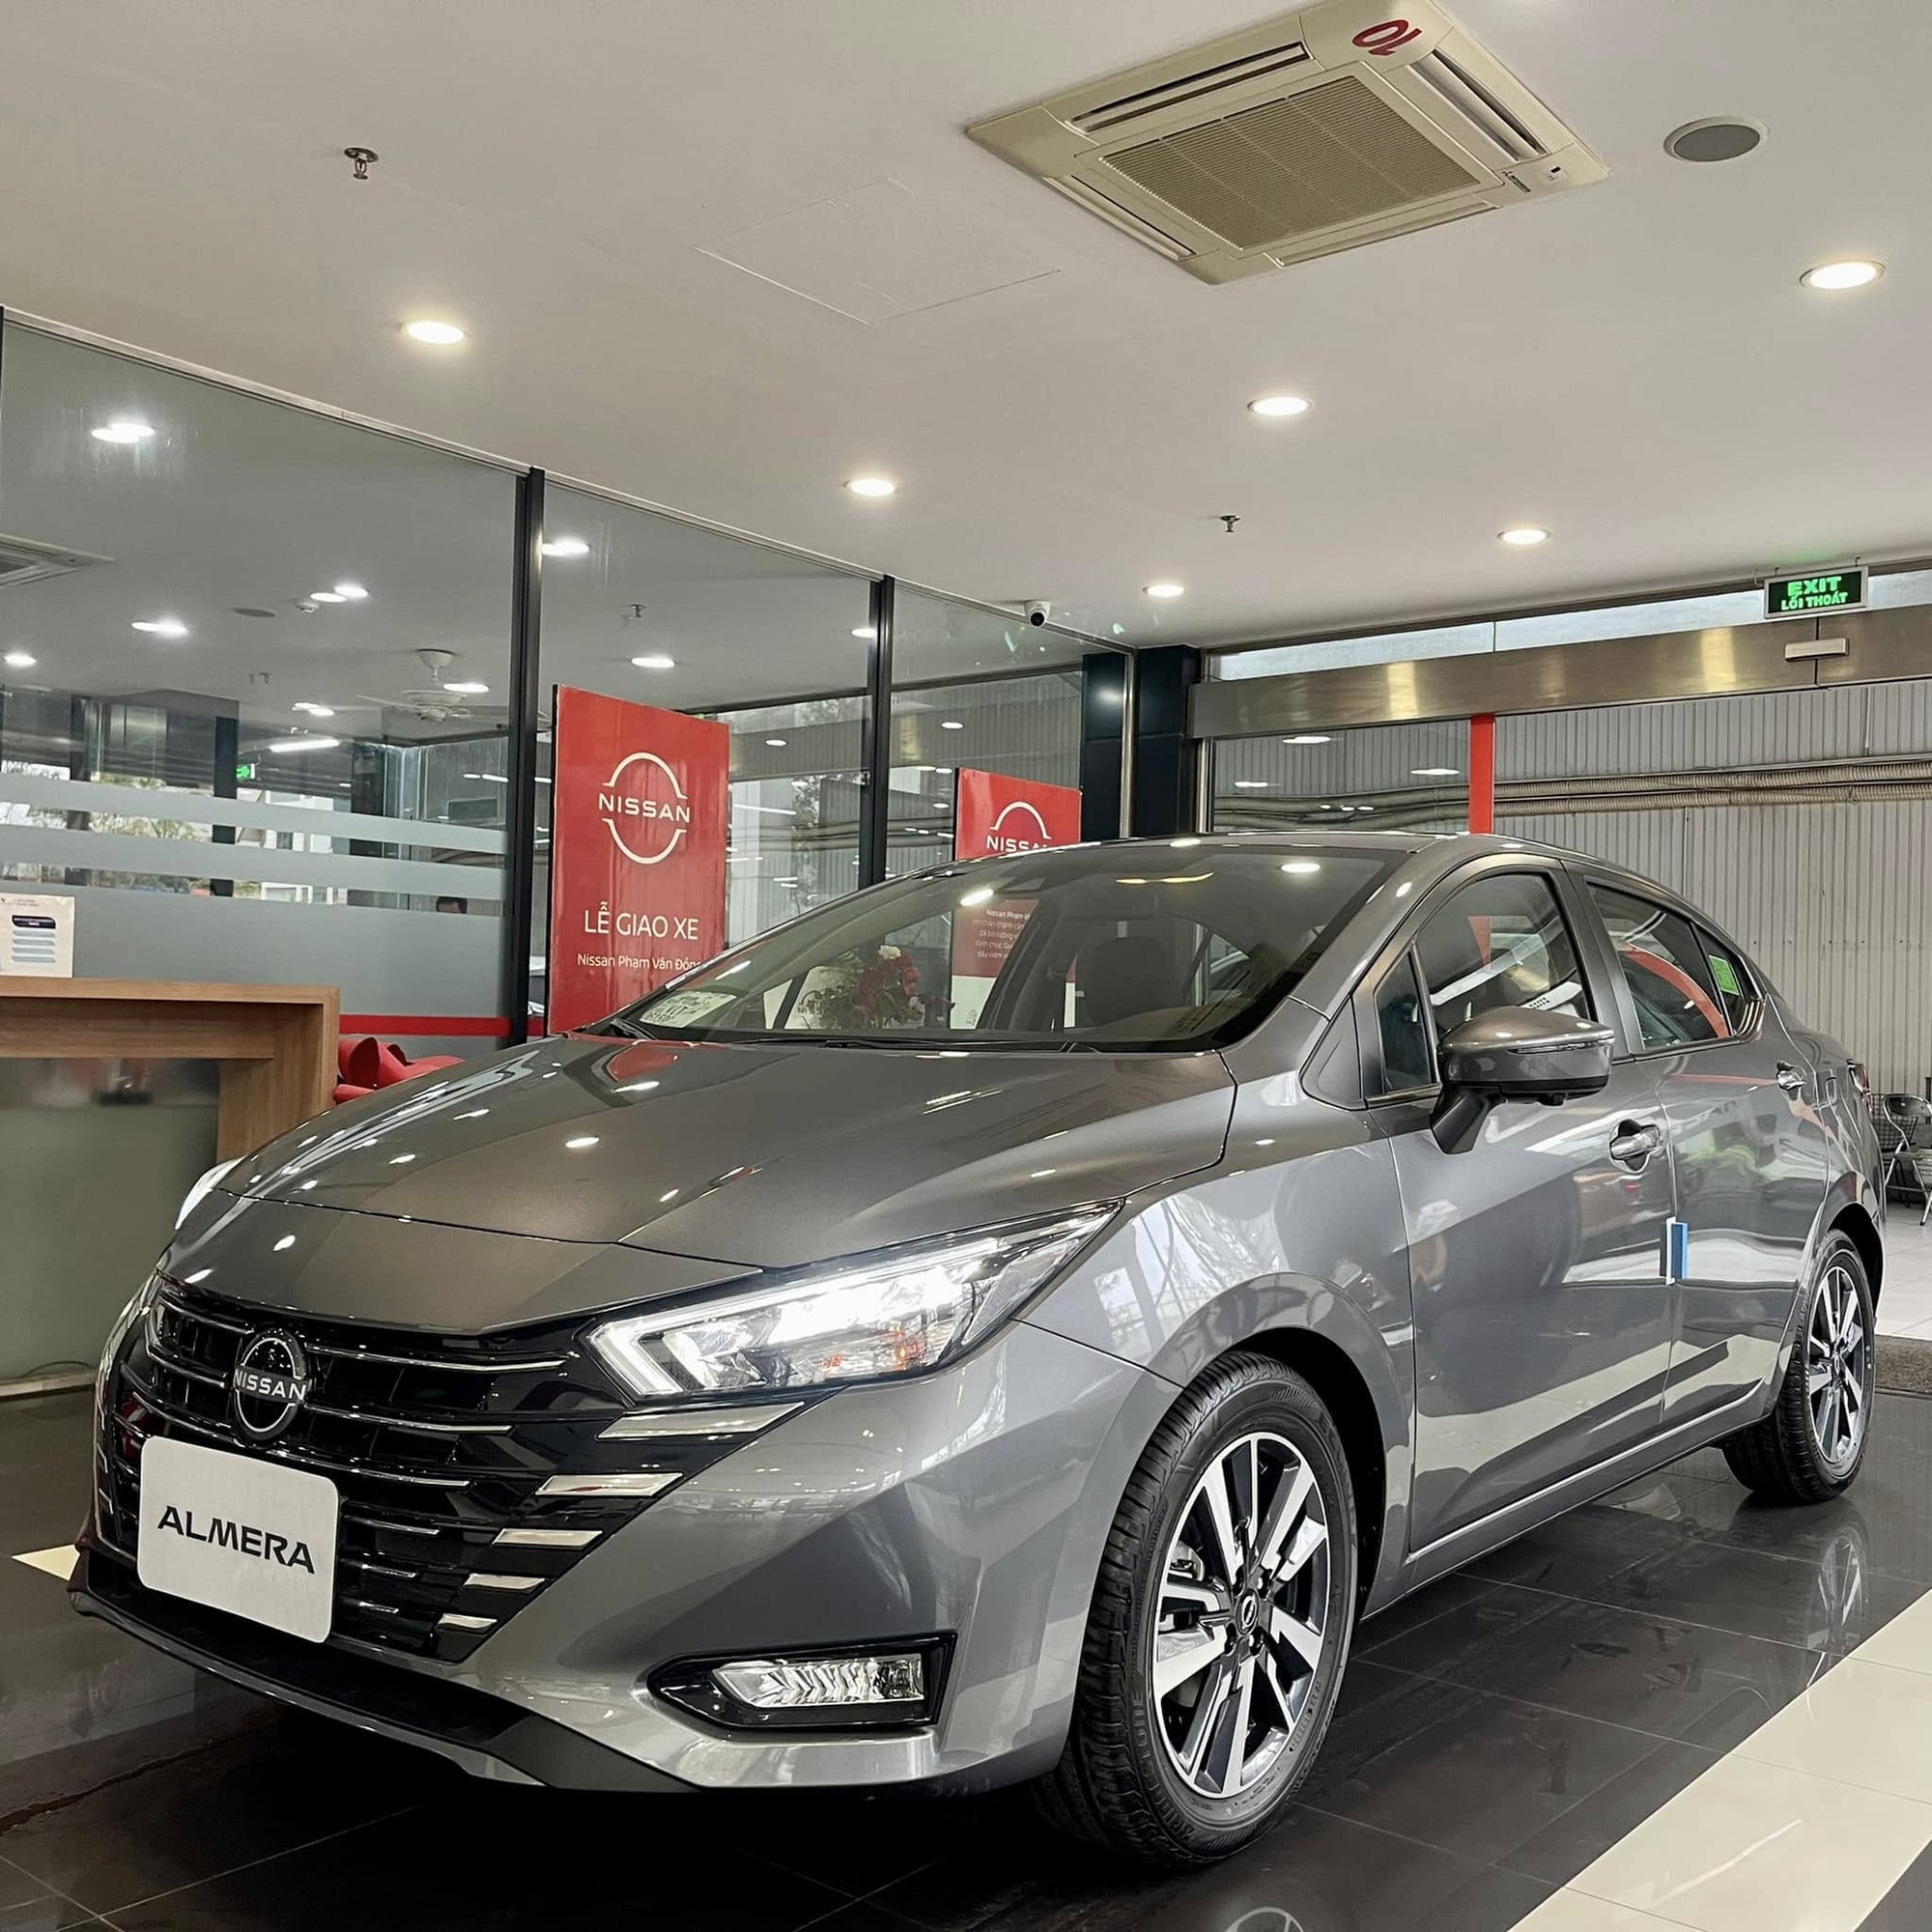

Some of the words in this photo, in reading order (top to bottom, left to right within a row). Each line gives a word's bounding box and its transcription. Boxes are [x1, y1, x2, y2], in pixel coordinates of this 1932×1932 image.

[1788, 576, 1842, 596] EXIT
[1805, 591, 1849, 608] THOÁT
[599, 792, 691, 823] NISSAN
[986, 835, 1048, 852] NISS
[584, 900, 611, 934] LỄ
[616, 913, 668, 938] GIAO
[673, 917, 699, 940] XE
[577, 952, 615, 967] Nissan
[233, 1368, 307, 1401] NISSAN
[157, 1505, 316, 1575] ALMERA
